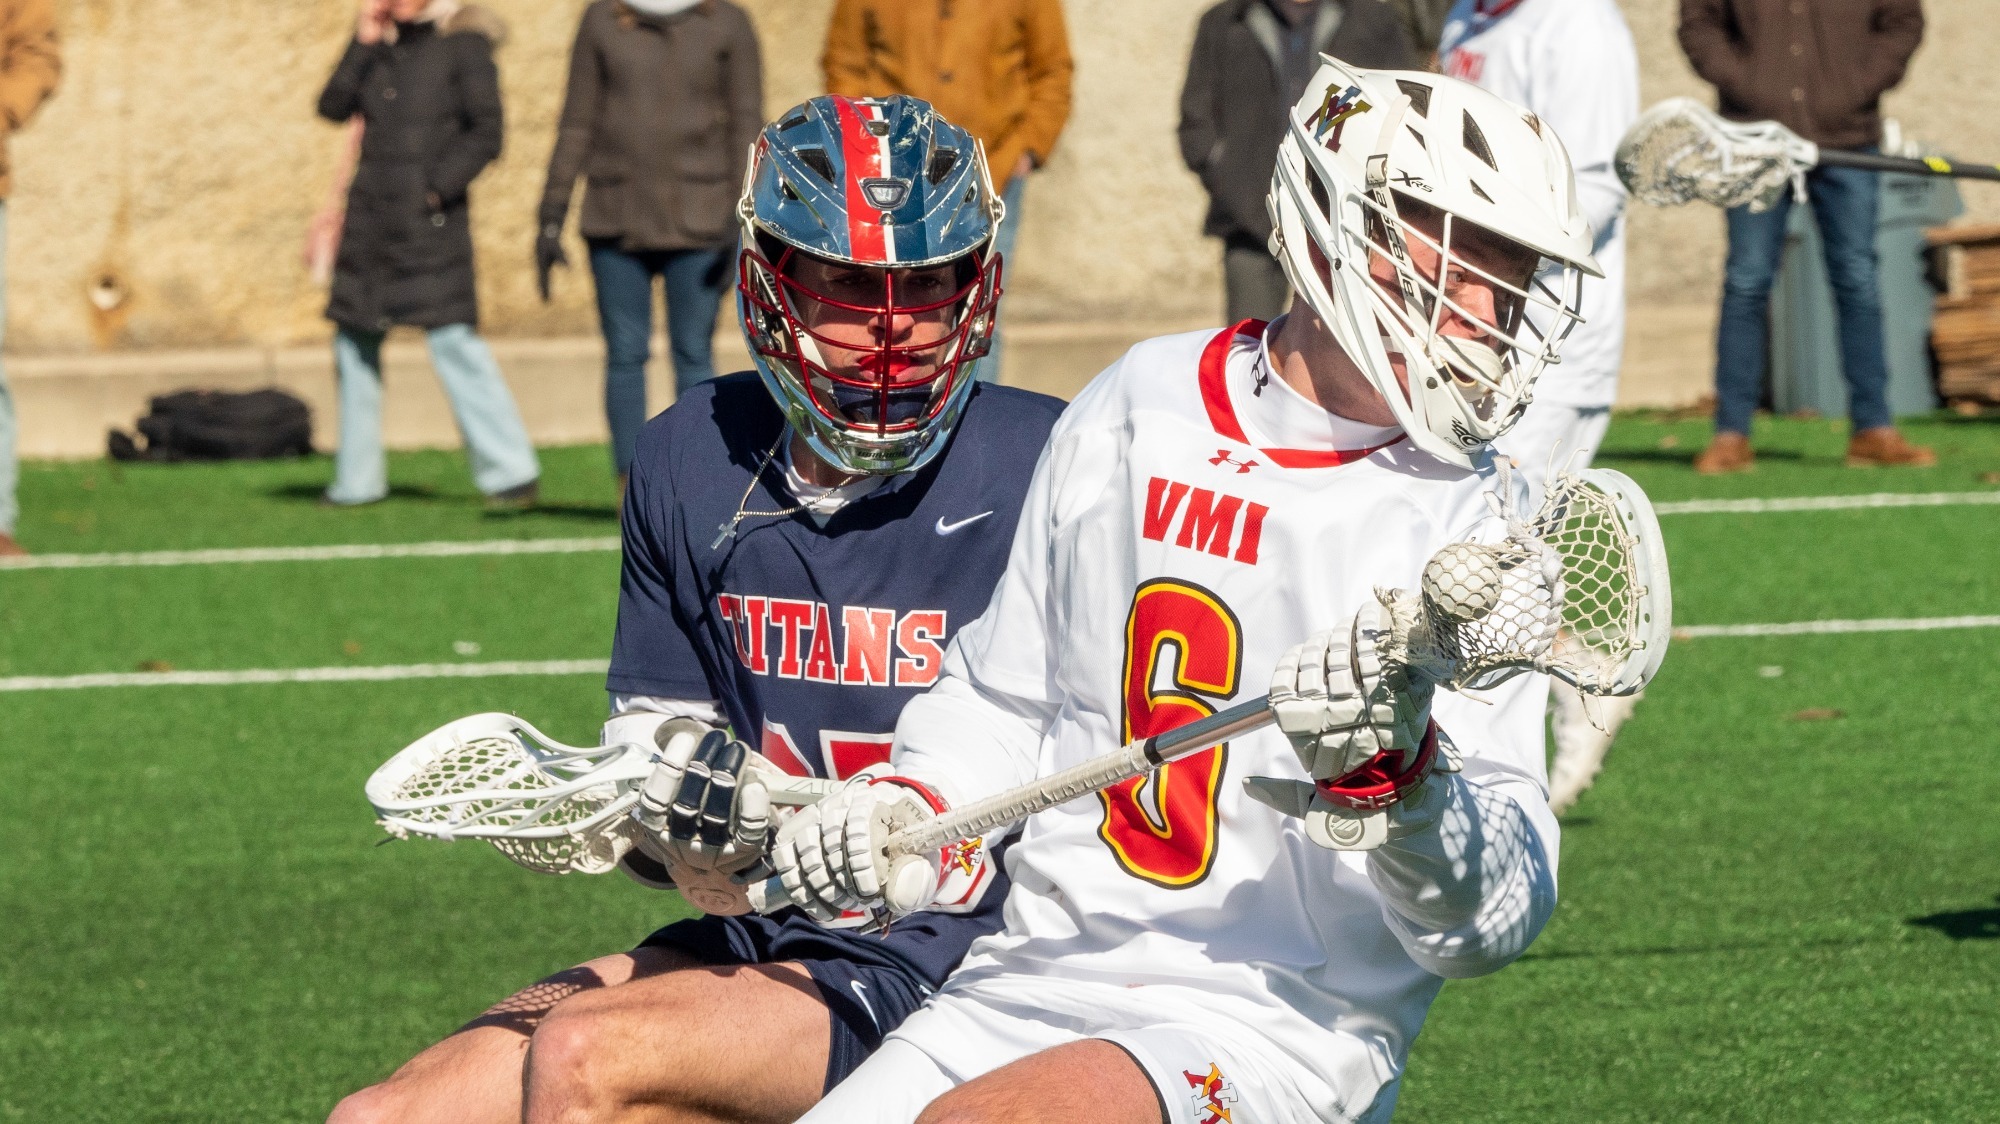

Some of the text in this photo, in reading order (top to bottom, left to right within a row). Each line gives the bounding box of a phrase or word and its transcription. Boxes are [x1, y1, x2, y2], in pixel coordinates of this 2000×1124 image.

[1142, 476, 1270, 566] VMI
[717, 592, 947, 687] TITANS
[1097, 577, 1243, 890] 6
